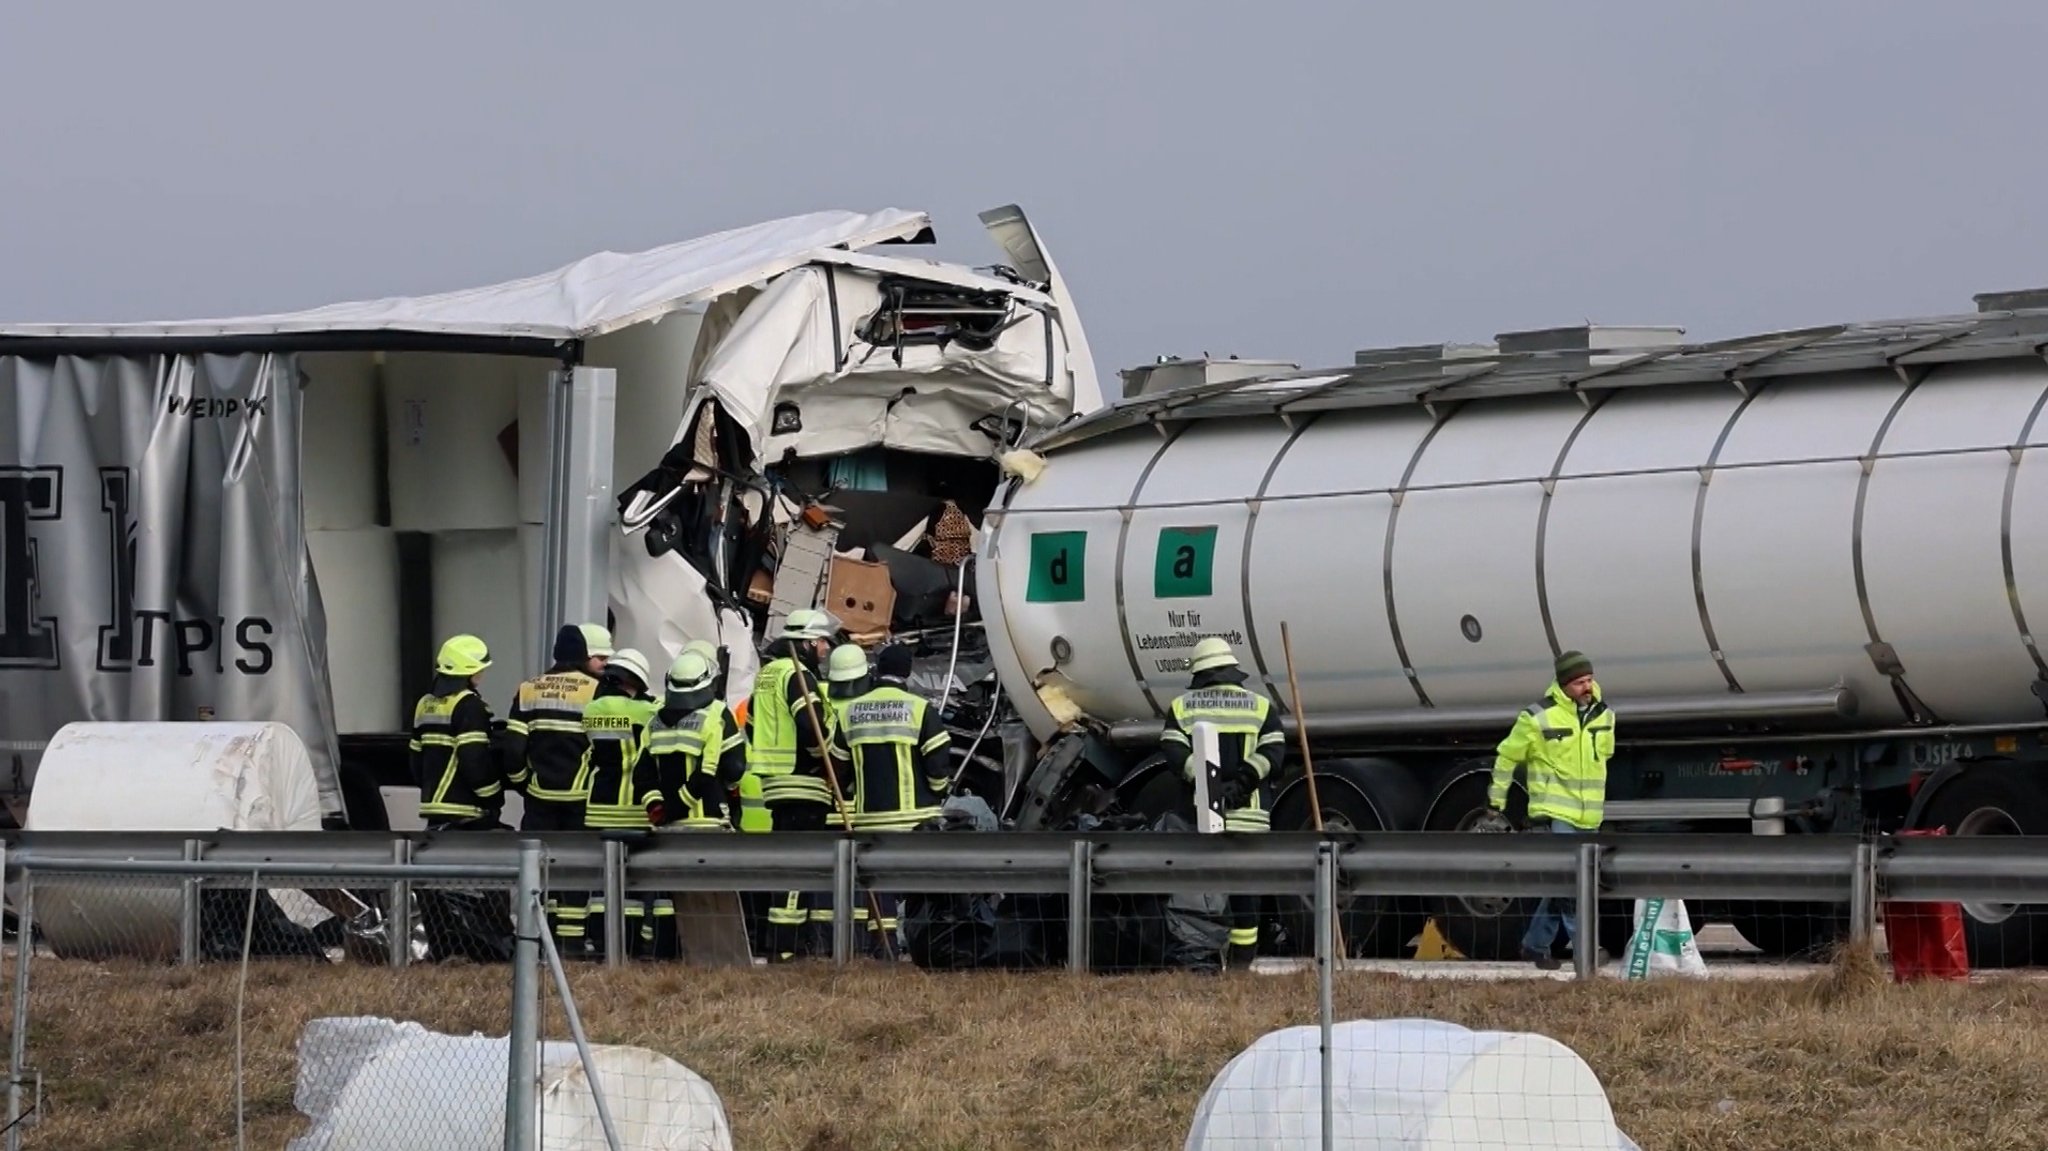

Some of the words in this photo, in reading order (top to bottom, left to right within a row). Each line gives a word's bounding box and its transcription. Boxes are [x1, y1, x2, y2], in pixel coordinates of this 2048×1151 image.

[1050, 548, 1068, 585] d
[1173, 545, 1196, 579] a
[1167, 610, 1185, 627] Nur
[1187, 610, 1201, 627] für
